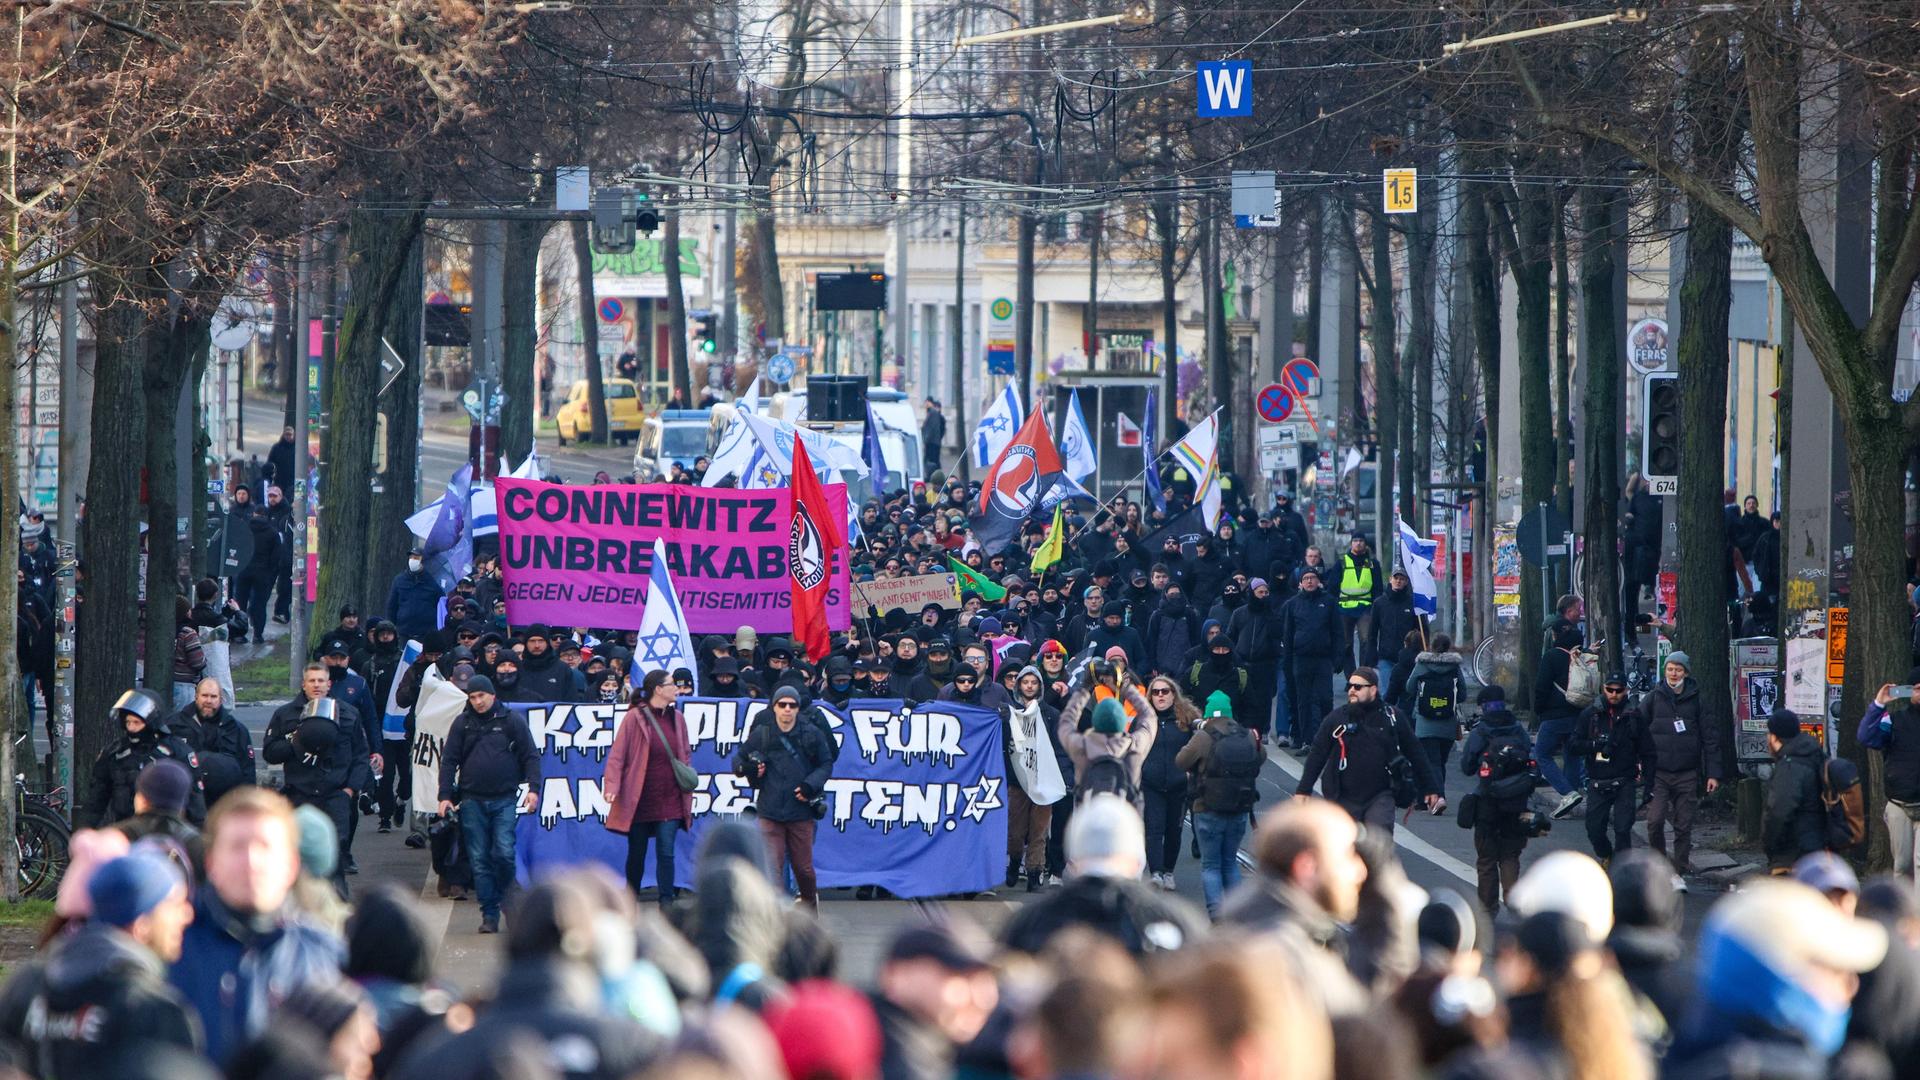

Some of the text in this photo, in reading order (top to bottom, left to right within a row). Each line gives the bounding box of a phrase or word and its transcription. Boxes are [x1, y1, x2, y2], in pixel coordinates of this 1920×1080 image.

[1203, 68, 1246, 110] W
[1389, 177, 1412, 208] 1,5
[1635, 348, 1667, 362] FERAS
[1656, 481, 1675, 493] 674
[504, 487, 777, 534] CONNEWITZ
[505, 533, 841, 580] UNBREAKAB
[507, 582, 574, 602] GEGEN
[578, 585, 651, 606] JEDEN
[868, 580, 905, 591] FRIEDEN
[909, 578, 926, 586] MIT
[527, 702, 631, 763] KEI
[851, 706, 967, 768] FÜR
[302, 751, 318, 766] 71
